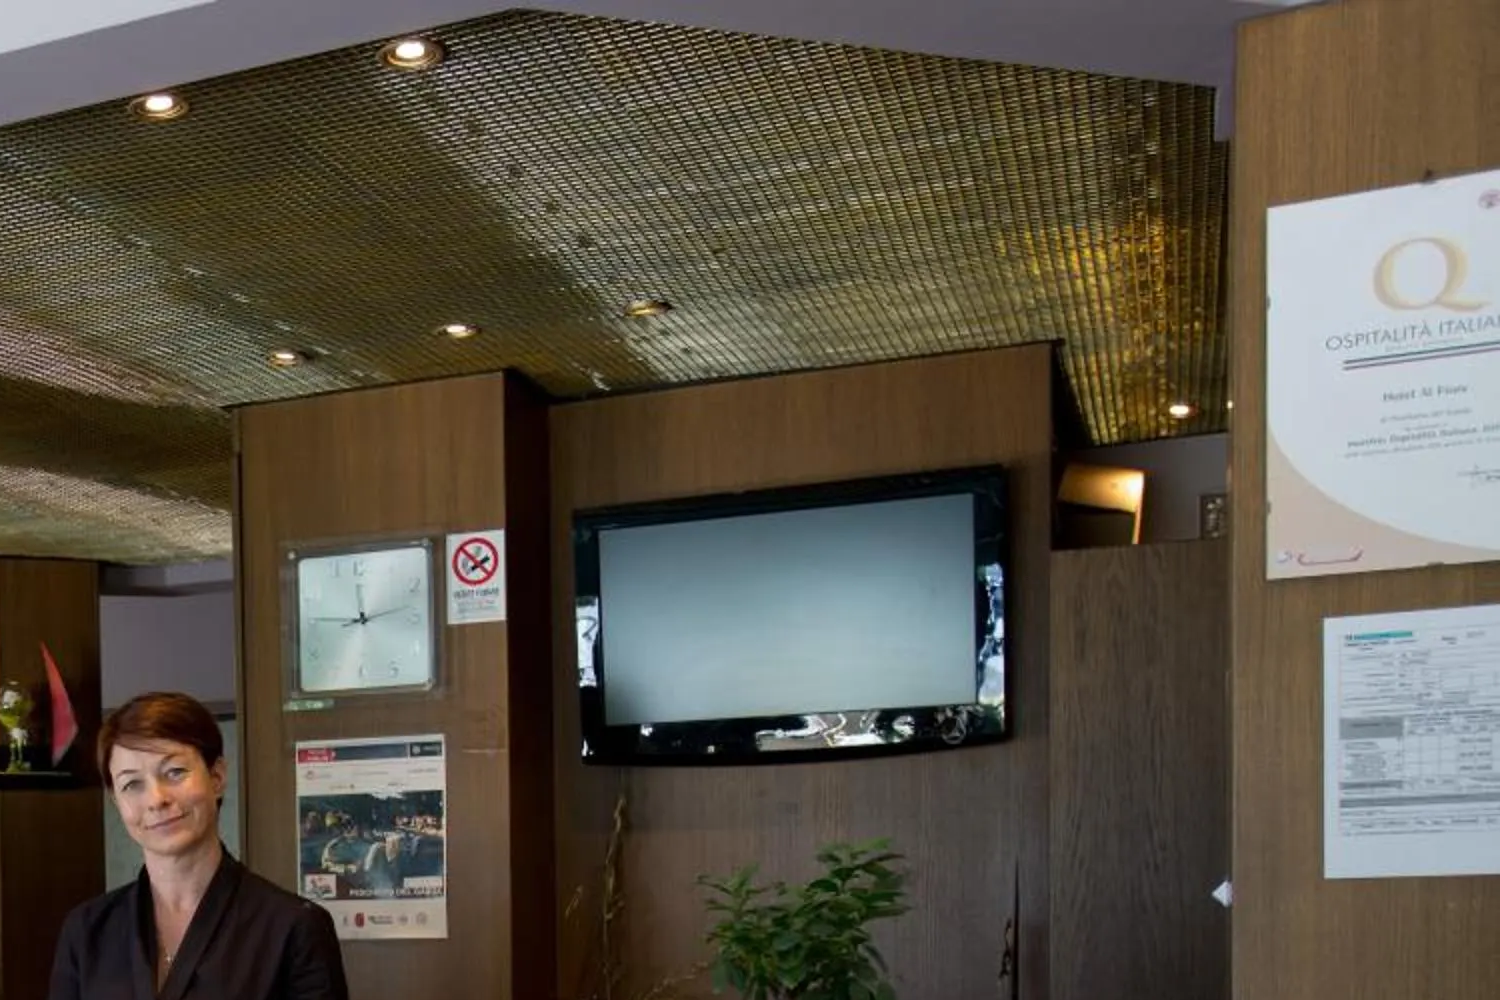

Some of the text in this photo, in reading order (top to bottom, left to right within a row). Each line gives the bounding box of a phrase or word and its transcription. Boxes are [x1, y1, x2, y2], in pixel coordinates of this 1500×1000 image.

[1372, 236, 1492, 312] Q
[1325, 320, 1432, 351] OSPITALITÀ
[1438, 315, 1500, 337] ITALIA
